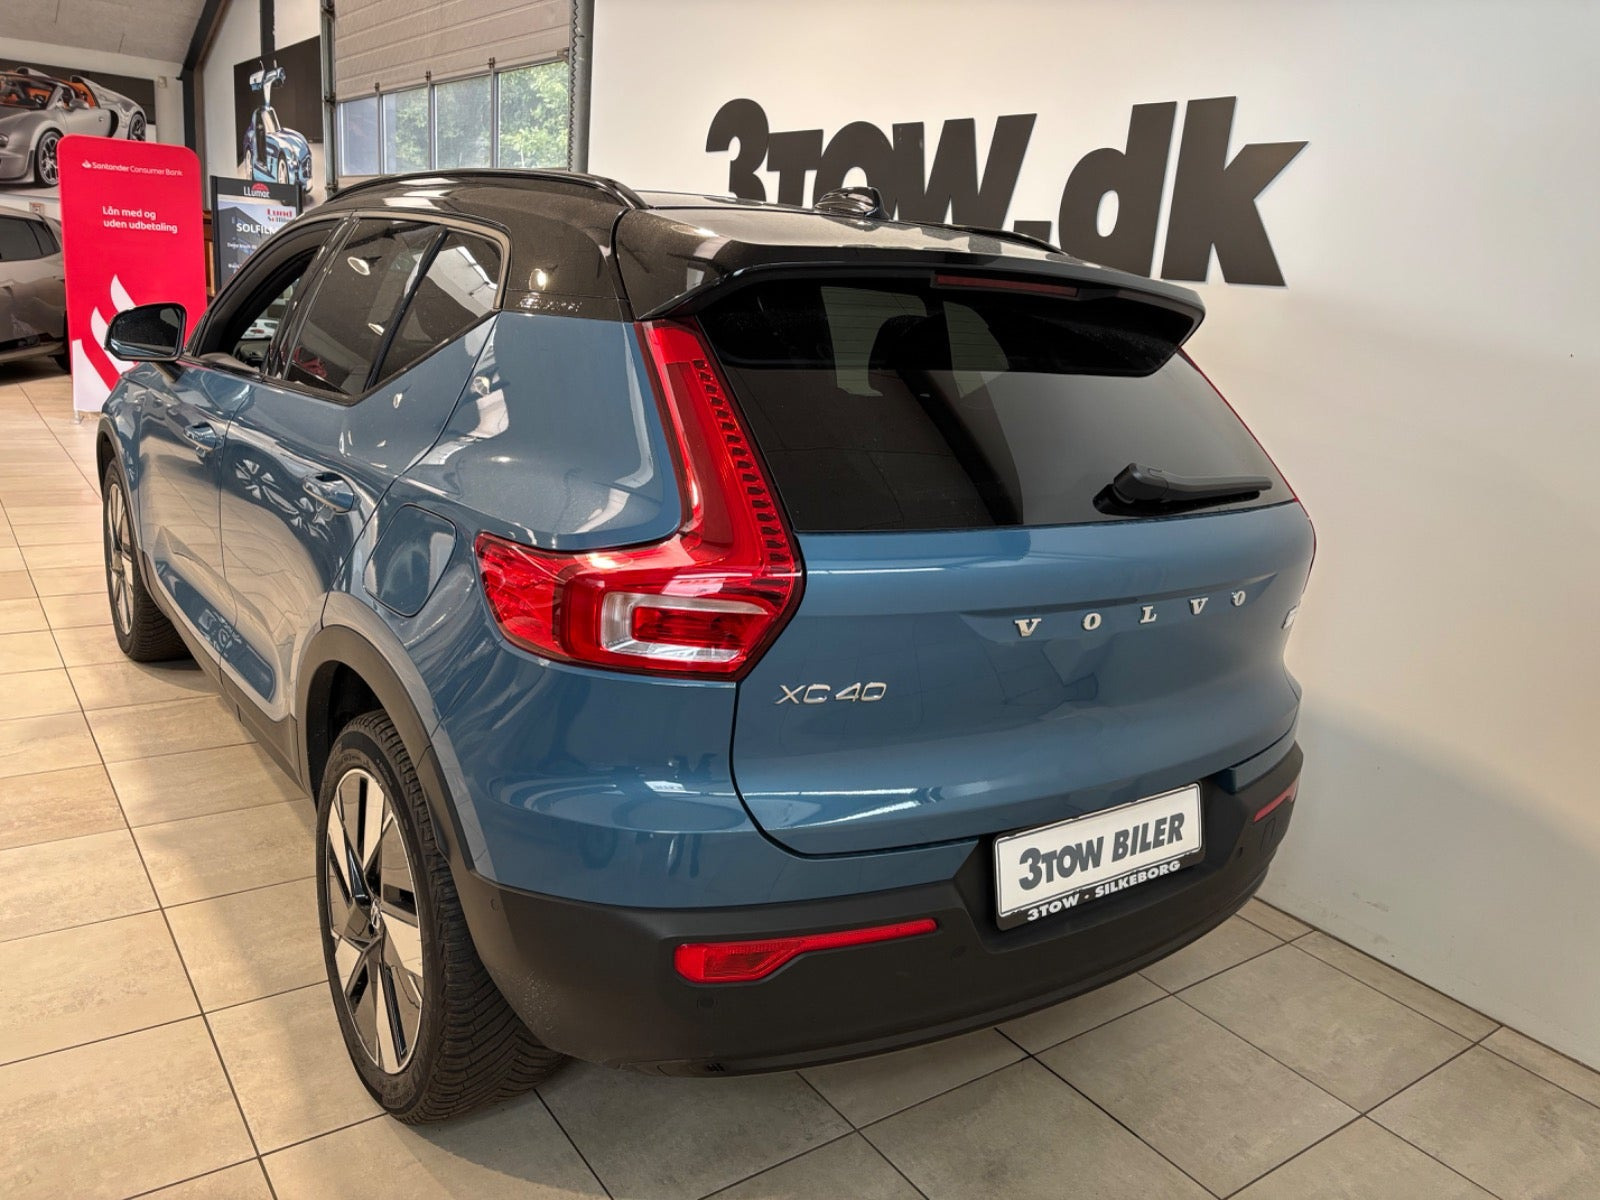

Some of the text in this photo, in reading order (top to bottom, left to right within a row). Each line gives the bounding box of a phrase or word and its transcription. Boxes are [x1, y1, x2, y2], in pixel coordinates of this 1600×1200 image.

[91, 161, 183, 176] Santander Consumer Bank
[102, 205, 156, 220] Lån med og
[103, 219, 178, 234] uden udbetaling
[1014, 590, 1246, 637] VOLVO
[1018, 812, 1185, 891] 3TOW BILER
[1027, 860, 1181, 921] 3TOW SILKEBORG
